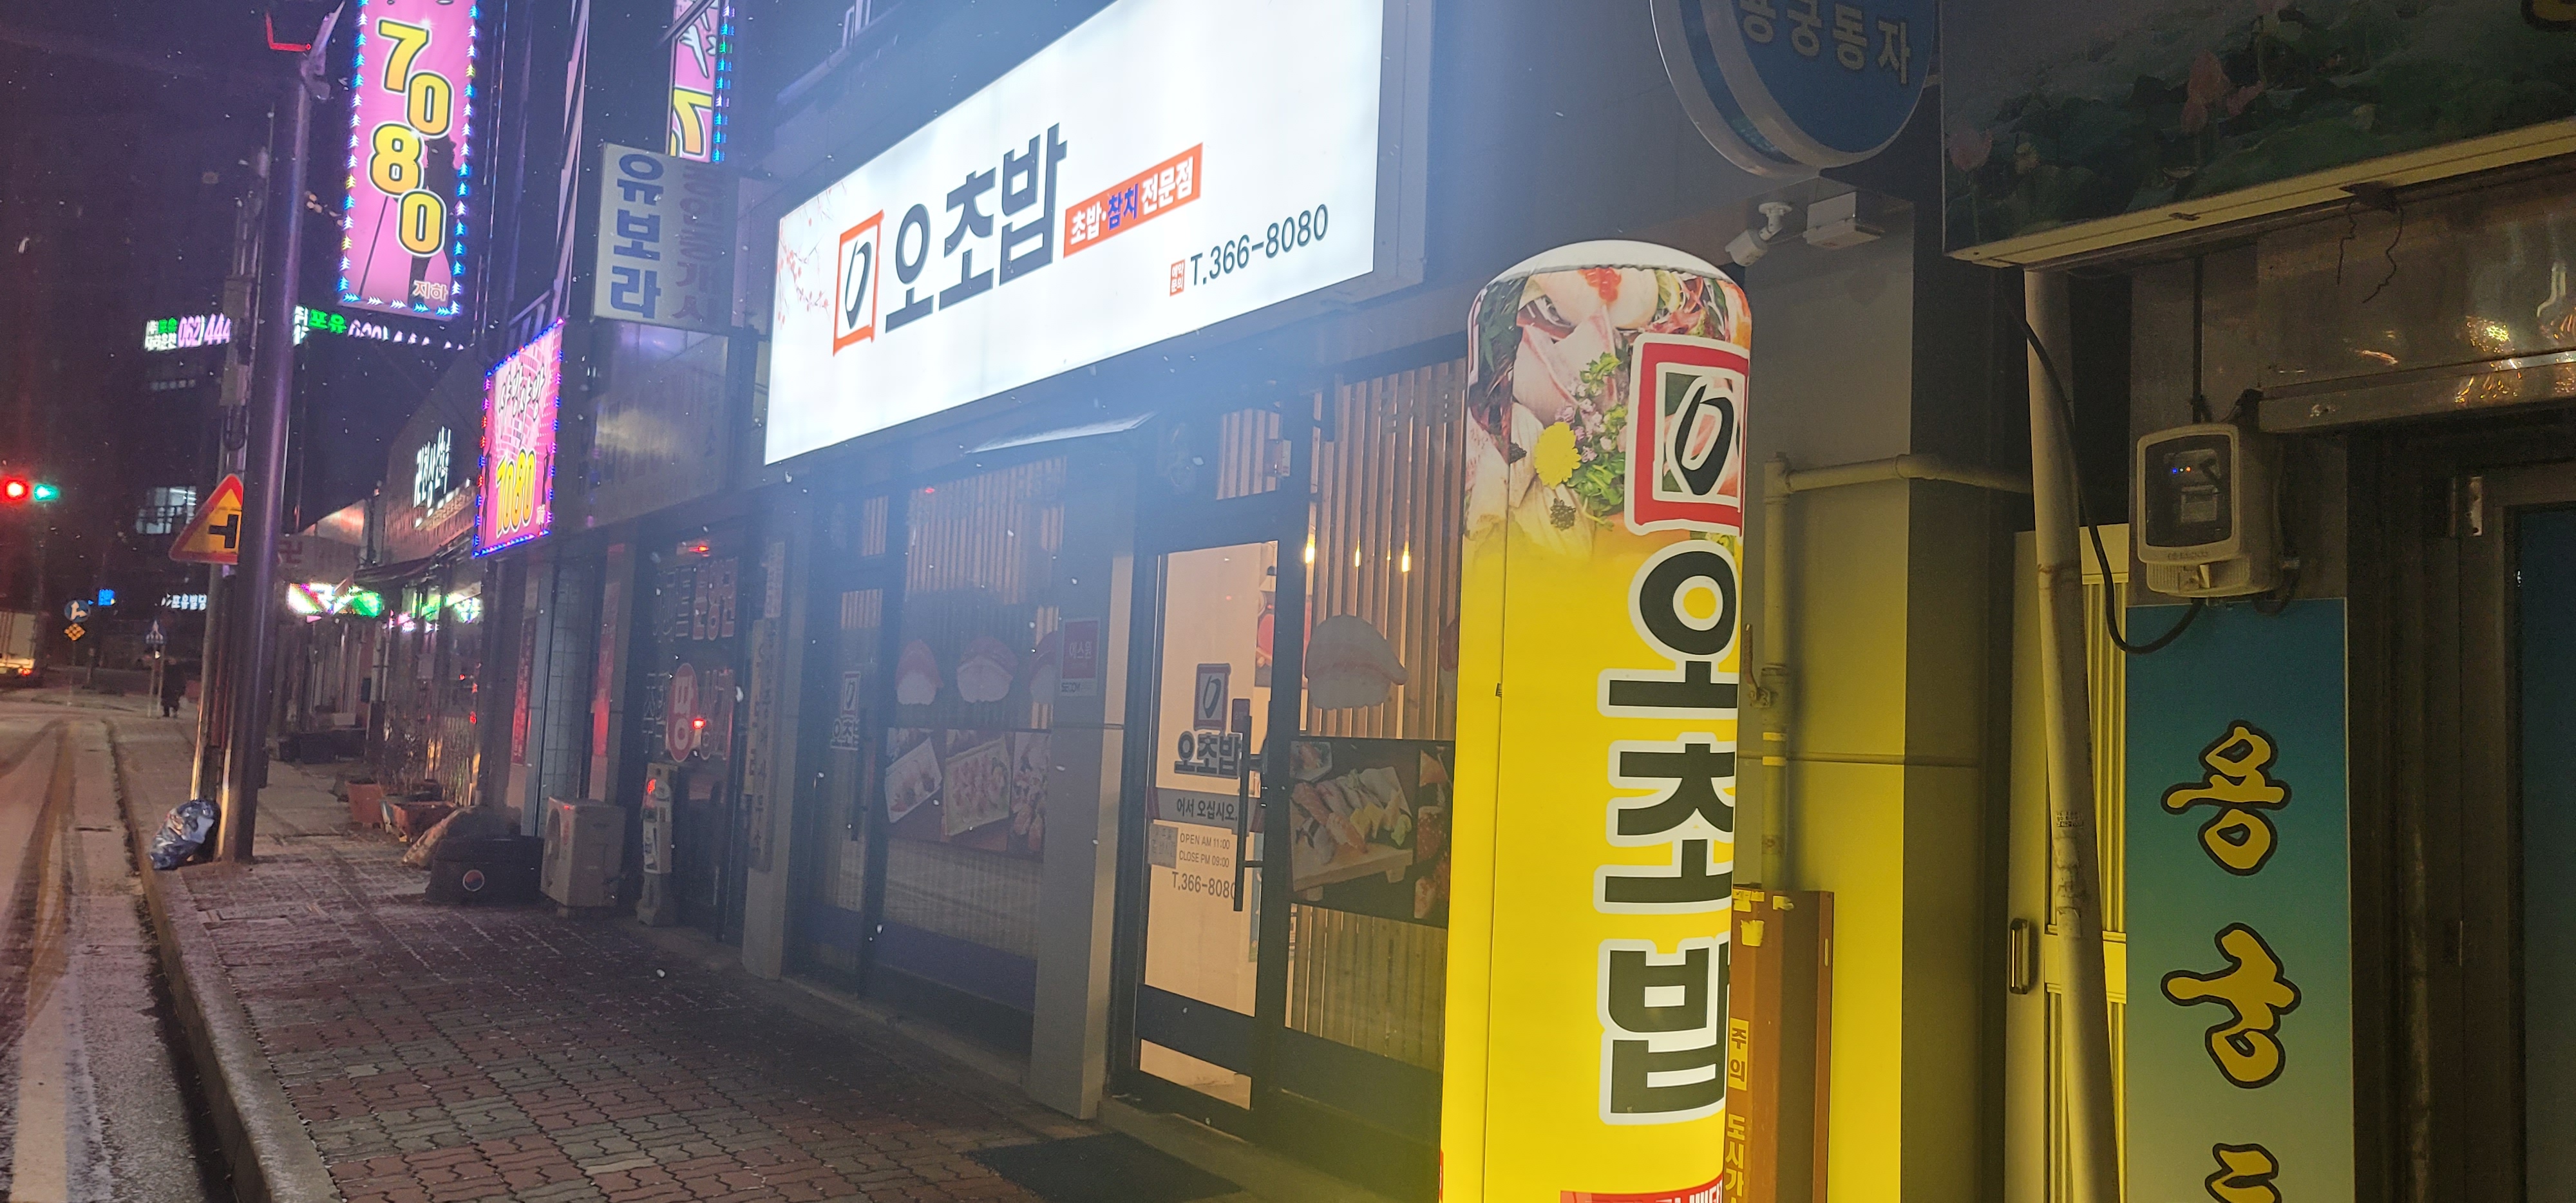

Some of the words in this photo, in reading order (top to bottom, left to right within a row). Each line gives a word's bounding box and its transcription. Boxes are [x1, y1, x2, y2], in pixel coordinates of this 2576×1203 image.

[370, 19, 453, 257] 7080
[1141, 156, 1194, 215] 전문점
[611, 153, 664, 319] 유보라
[885, 123, 1067, 334] 오초밥
[1191, 204, 1329, 286] T.366-8080
[413, 279, 449, 303] 지하
[1171, 261, 1184, 278] 예약
[1171, 277, 1183, 293] 문의
[1175, 732, 1242, 779] 오초밥
[1177, 797, 1195, 817] 어서
[1600, 547, 1740, 1117] 오초밥
[1179, 850, 1199, 863] CLOSE
[1200, 854, 1210, 864] PM
[1211, 855, 1229, 867] 09:00
[1180, 833, 1200, 846] OPEN
[1201, 835, 1211, 847] AM
[1213, 838, 1230, 849] 11:00
[1729, 1027, 1747, 1082] 주의
